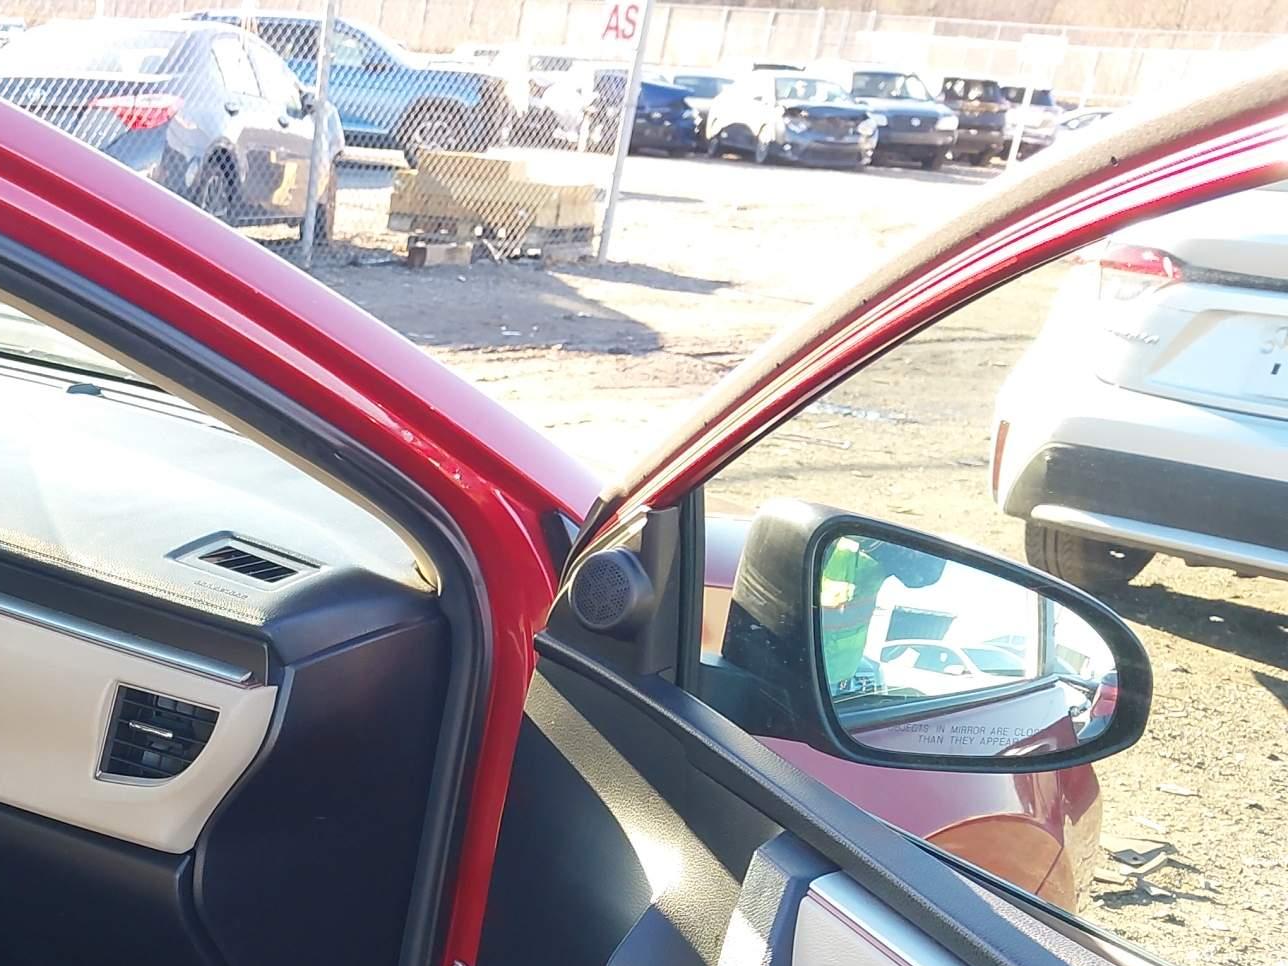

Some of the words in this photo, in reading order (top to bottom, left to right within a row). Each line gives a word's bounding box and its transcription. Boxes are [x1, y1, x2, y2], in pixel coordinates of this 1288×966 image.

[601, 4, 639, 40] AS
[936, 725, 945, 733] IN
[951, 726, 986, 735] MIRROR
[990, 727, 1009, 736] ARE
[919, 735, 943, 744] THAN
[950, 736, 975, 745] THEY
